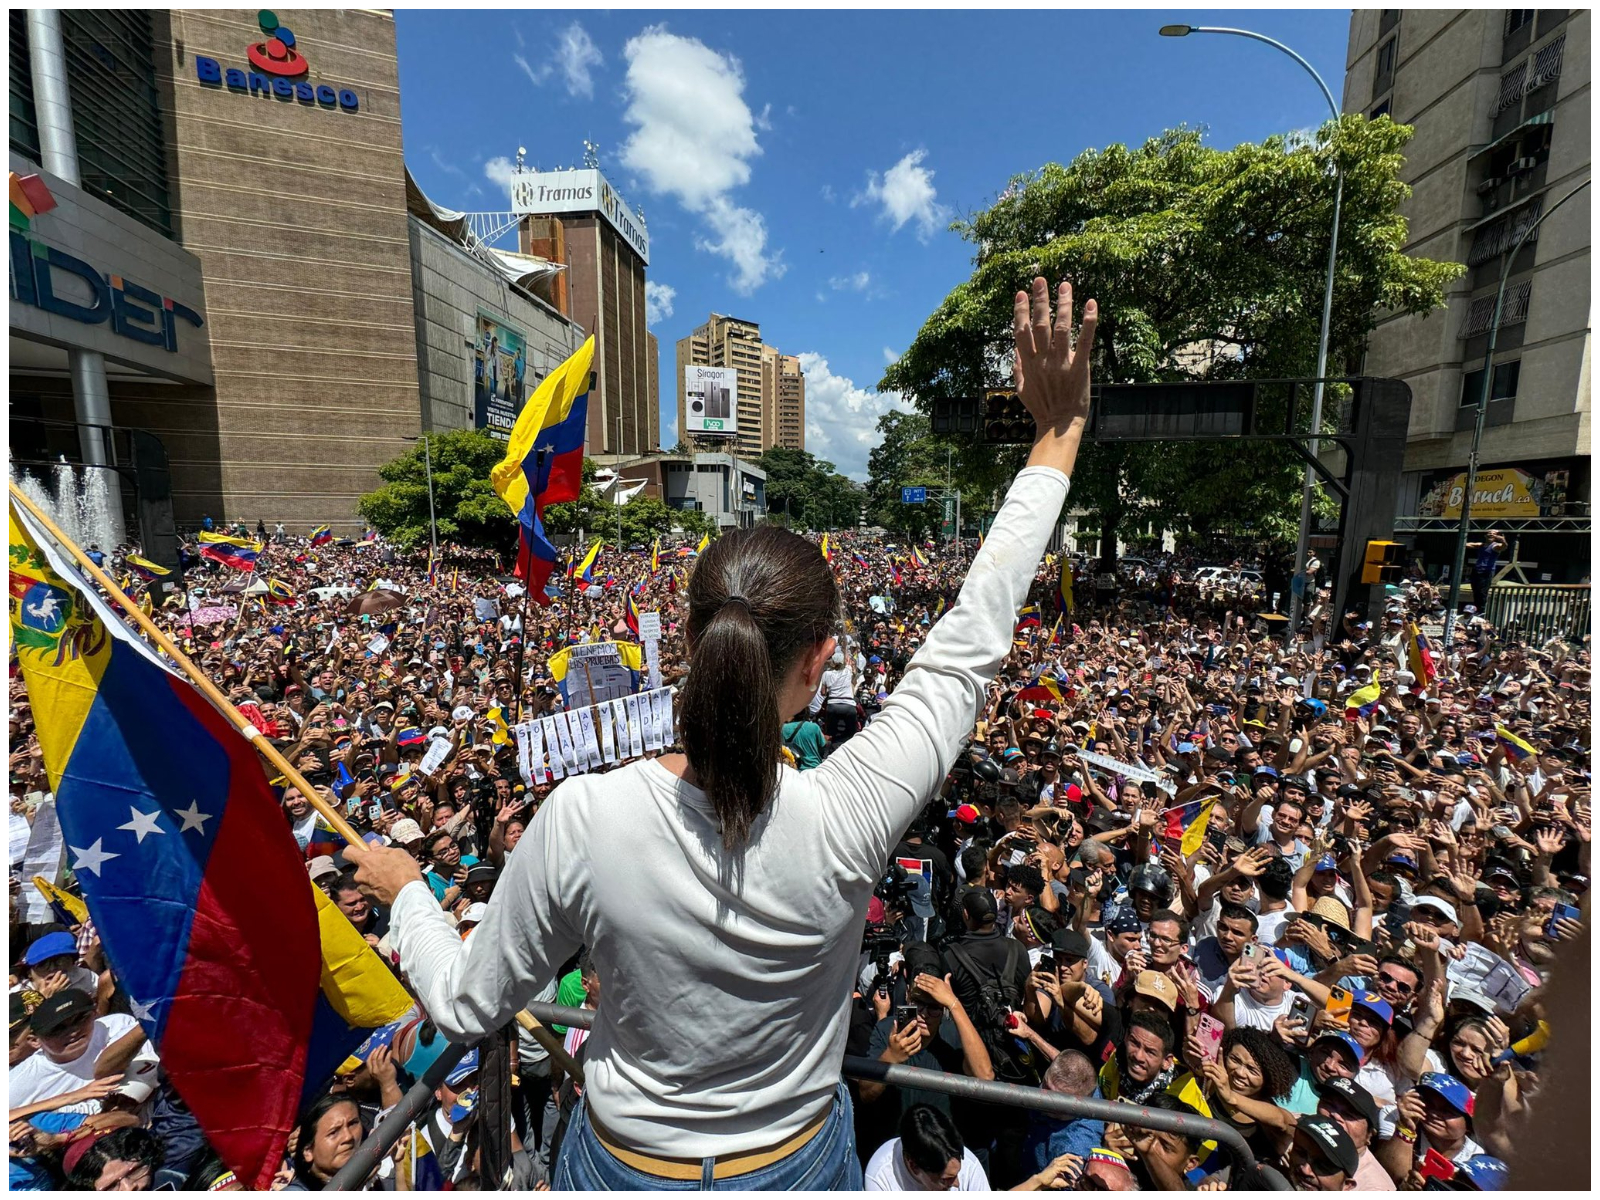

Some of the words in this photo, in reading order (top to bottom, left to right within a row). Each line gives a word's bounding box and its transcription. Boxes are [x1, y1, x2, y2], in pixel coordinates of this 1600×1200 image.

[195, 55, 359, 110] Banesco
[538, 185, 593, 202] Tramas
[614, 197, 647, 255] Tramas
[486, 412, 516, 429] TIENDA
[1463, 474, 1504, 483] BDEGON
[1449, 483, 1514, 508] Bruch
[585, 654, 619, 667] PRUEBAS
[601, 690, 670, 713] VERDAD
